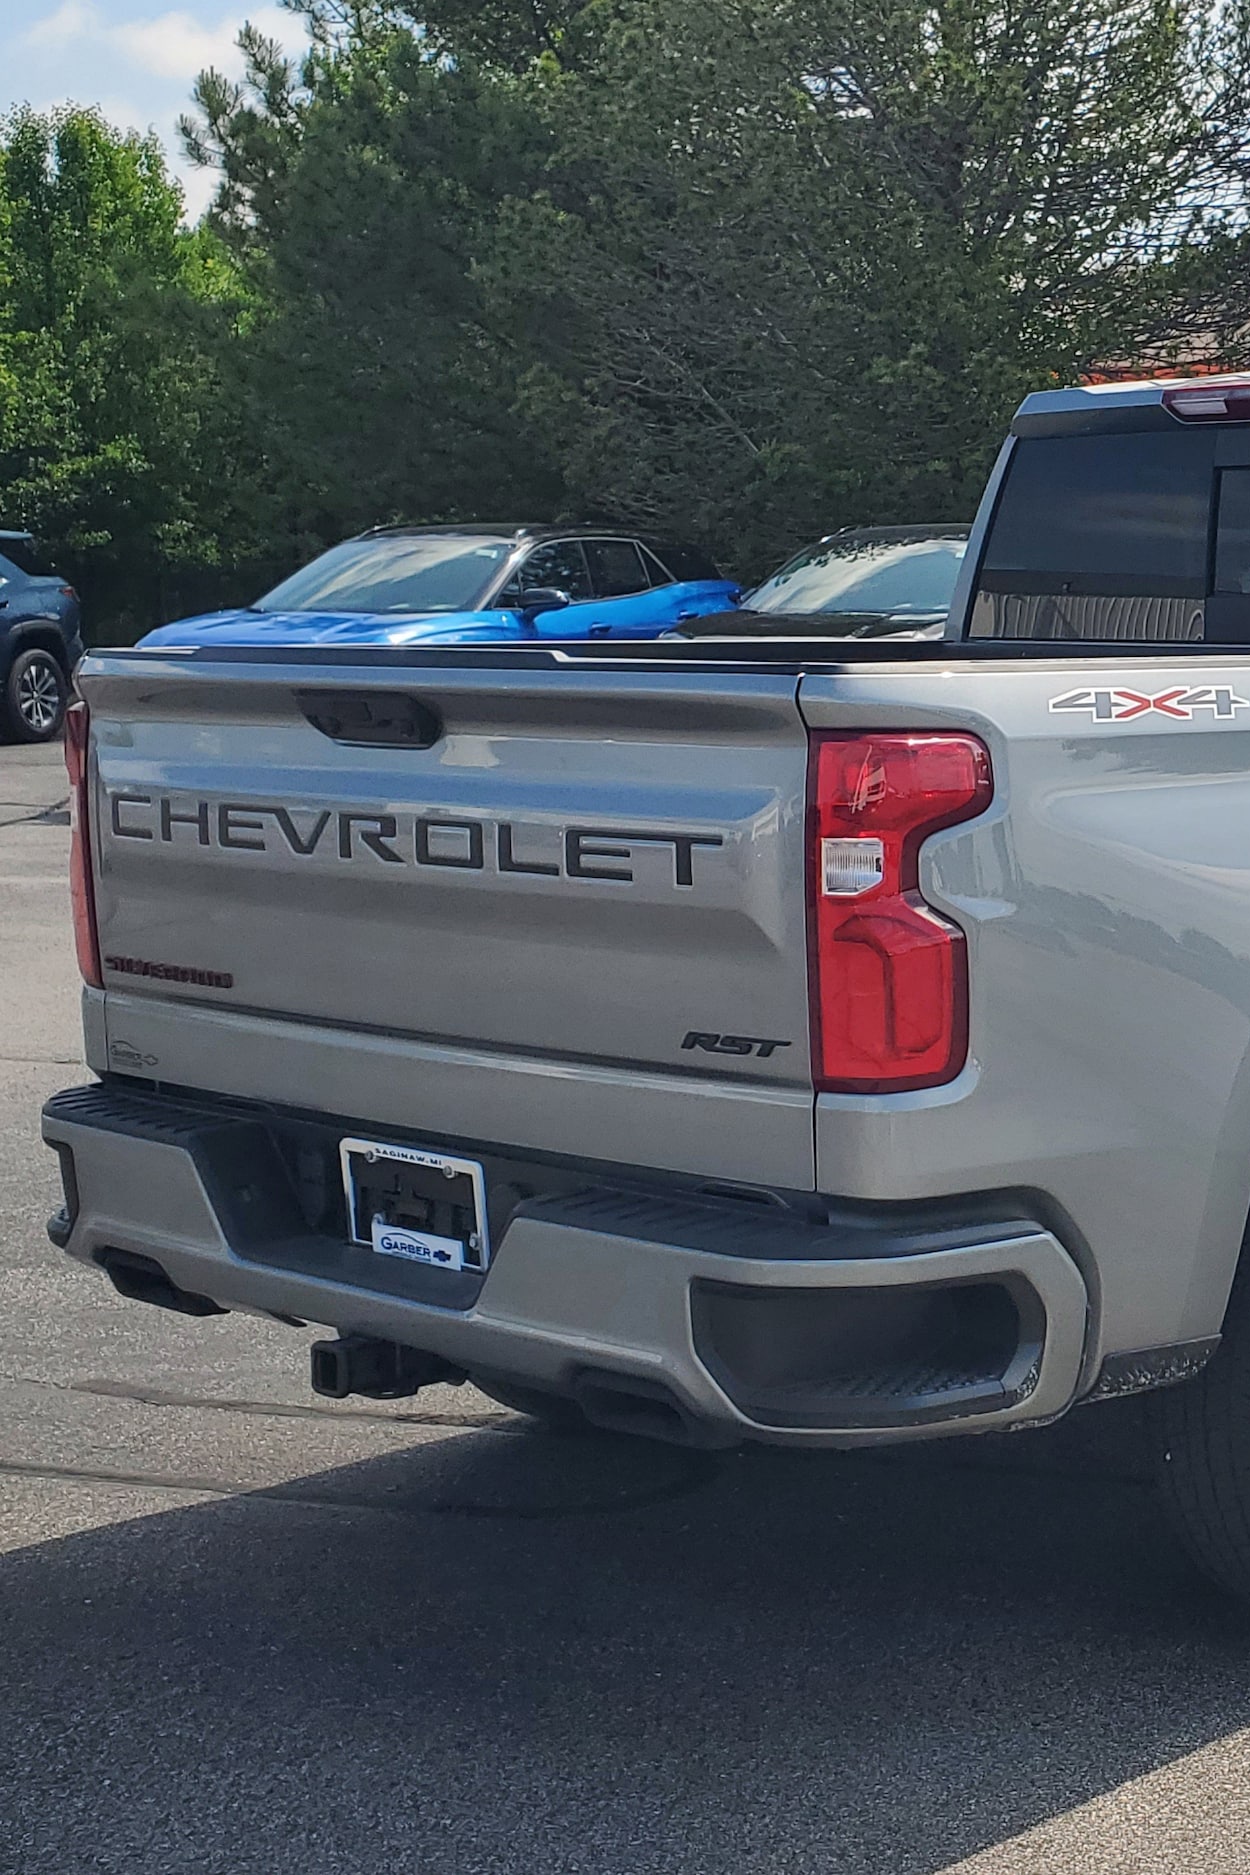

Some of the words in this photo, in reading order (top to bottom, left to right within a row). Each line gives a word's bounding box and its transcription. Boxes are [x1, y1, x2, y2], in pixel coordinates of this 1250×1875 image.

[111, 795, 723, 886] CHEVROLET
[680, 1031, 793, 1058] RST
[380, 1236, 431, 1257] GARBER
